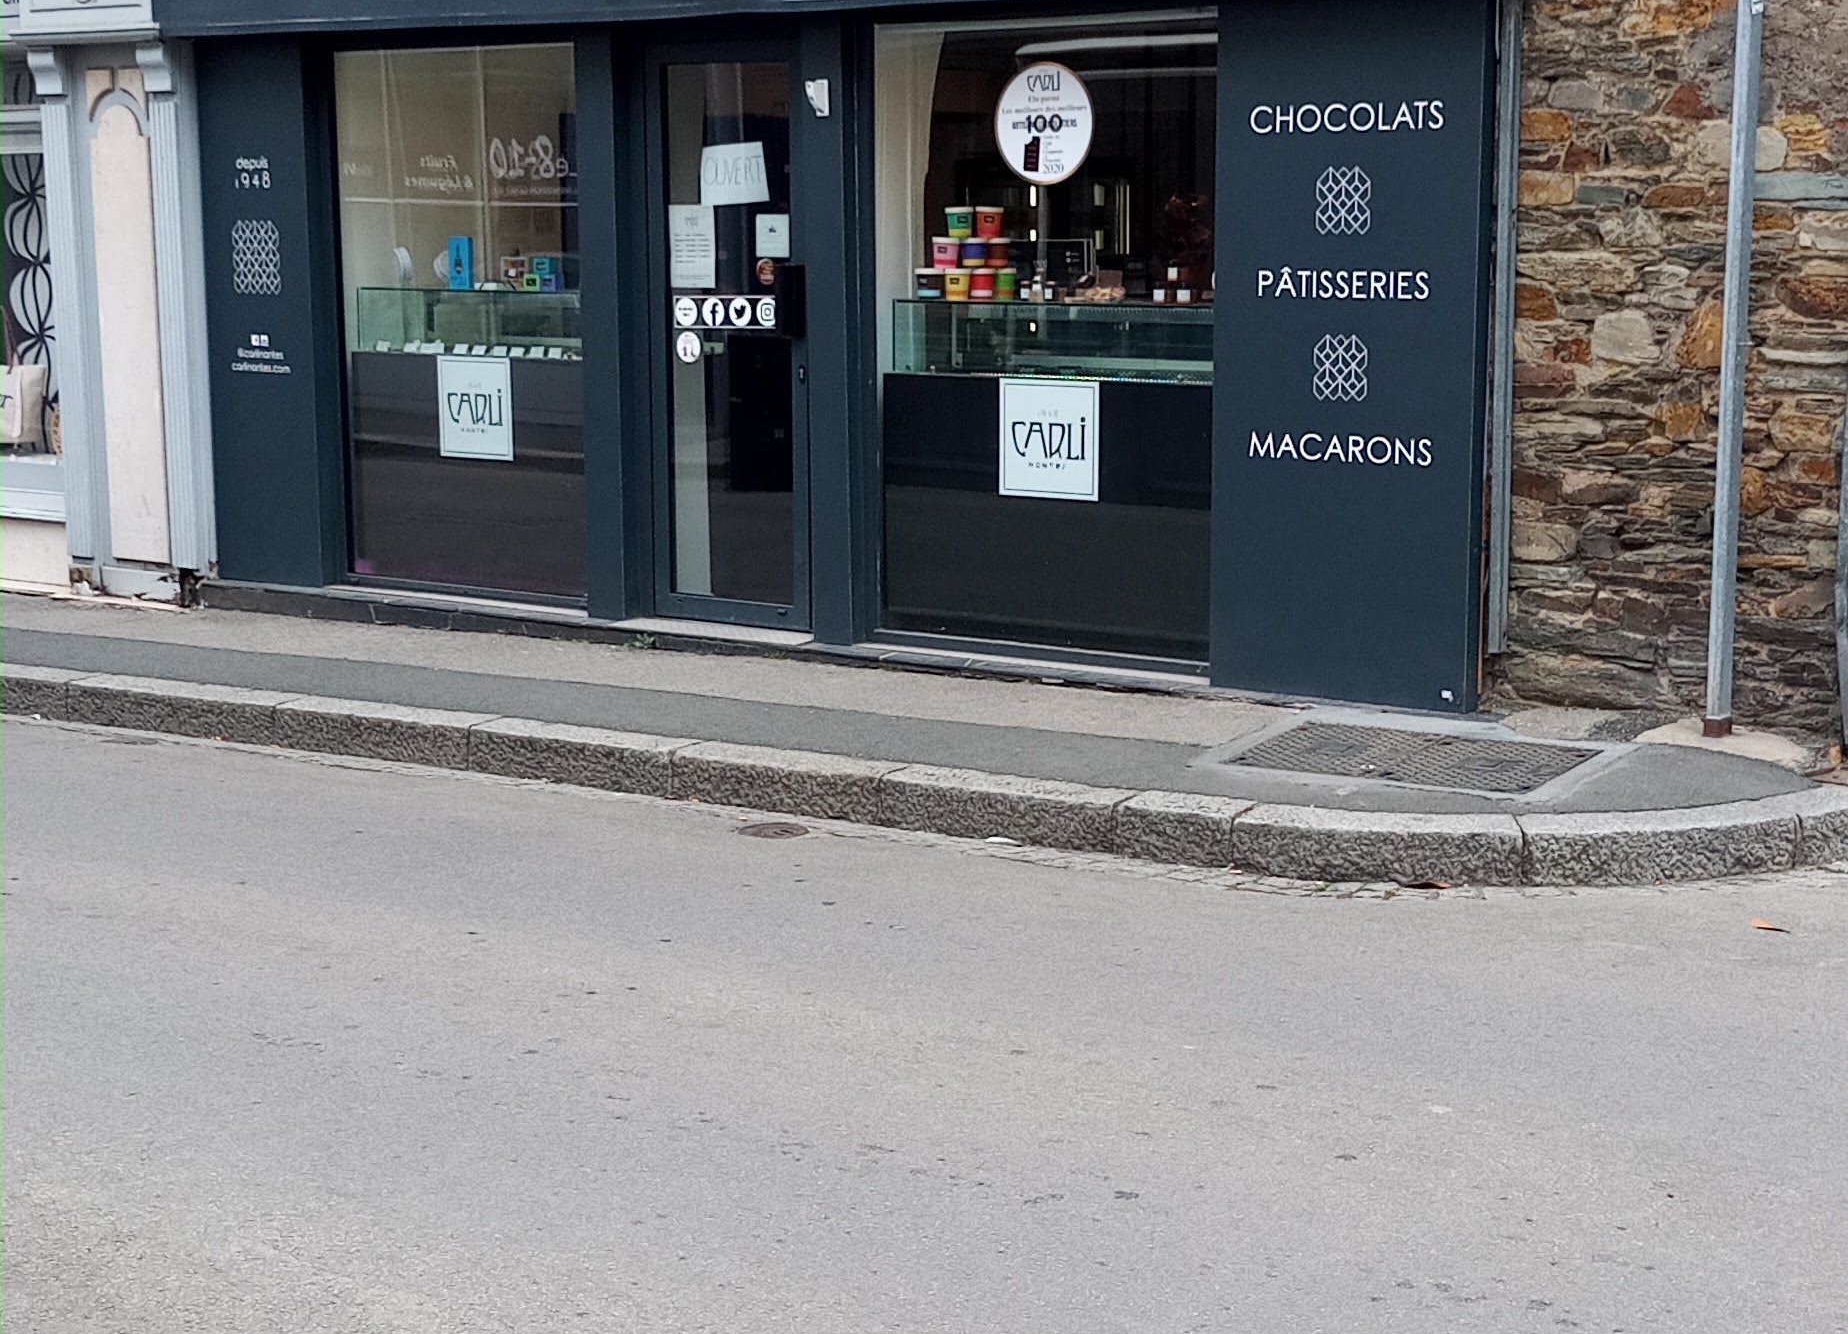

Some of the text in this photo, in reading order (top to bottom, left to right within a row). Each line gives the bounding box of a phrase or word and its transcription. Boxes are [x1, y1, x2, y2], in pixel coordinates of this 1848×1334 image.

[1026, 114, 1063, 134] 100
[1250, 100, 1444, 134] CHOCOLATS
[236, 156, 269, 171] depuis
[703, 155, 762, 186] OUVERT
[234, 171, 270, 189] 1948
[1256, 266, 1430, 300] PÂTISSERIES
[1248, 431, 1432, 467] MACARONS
